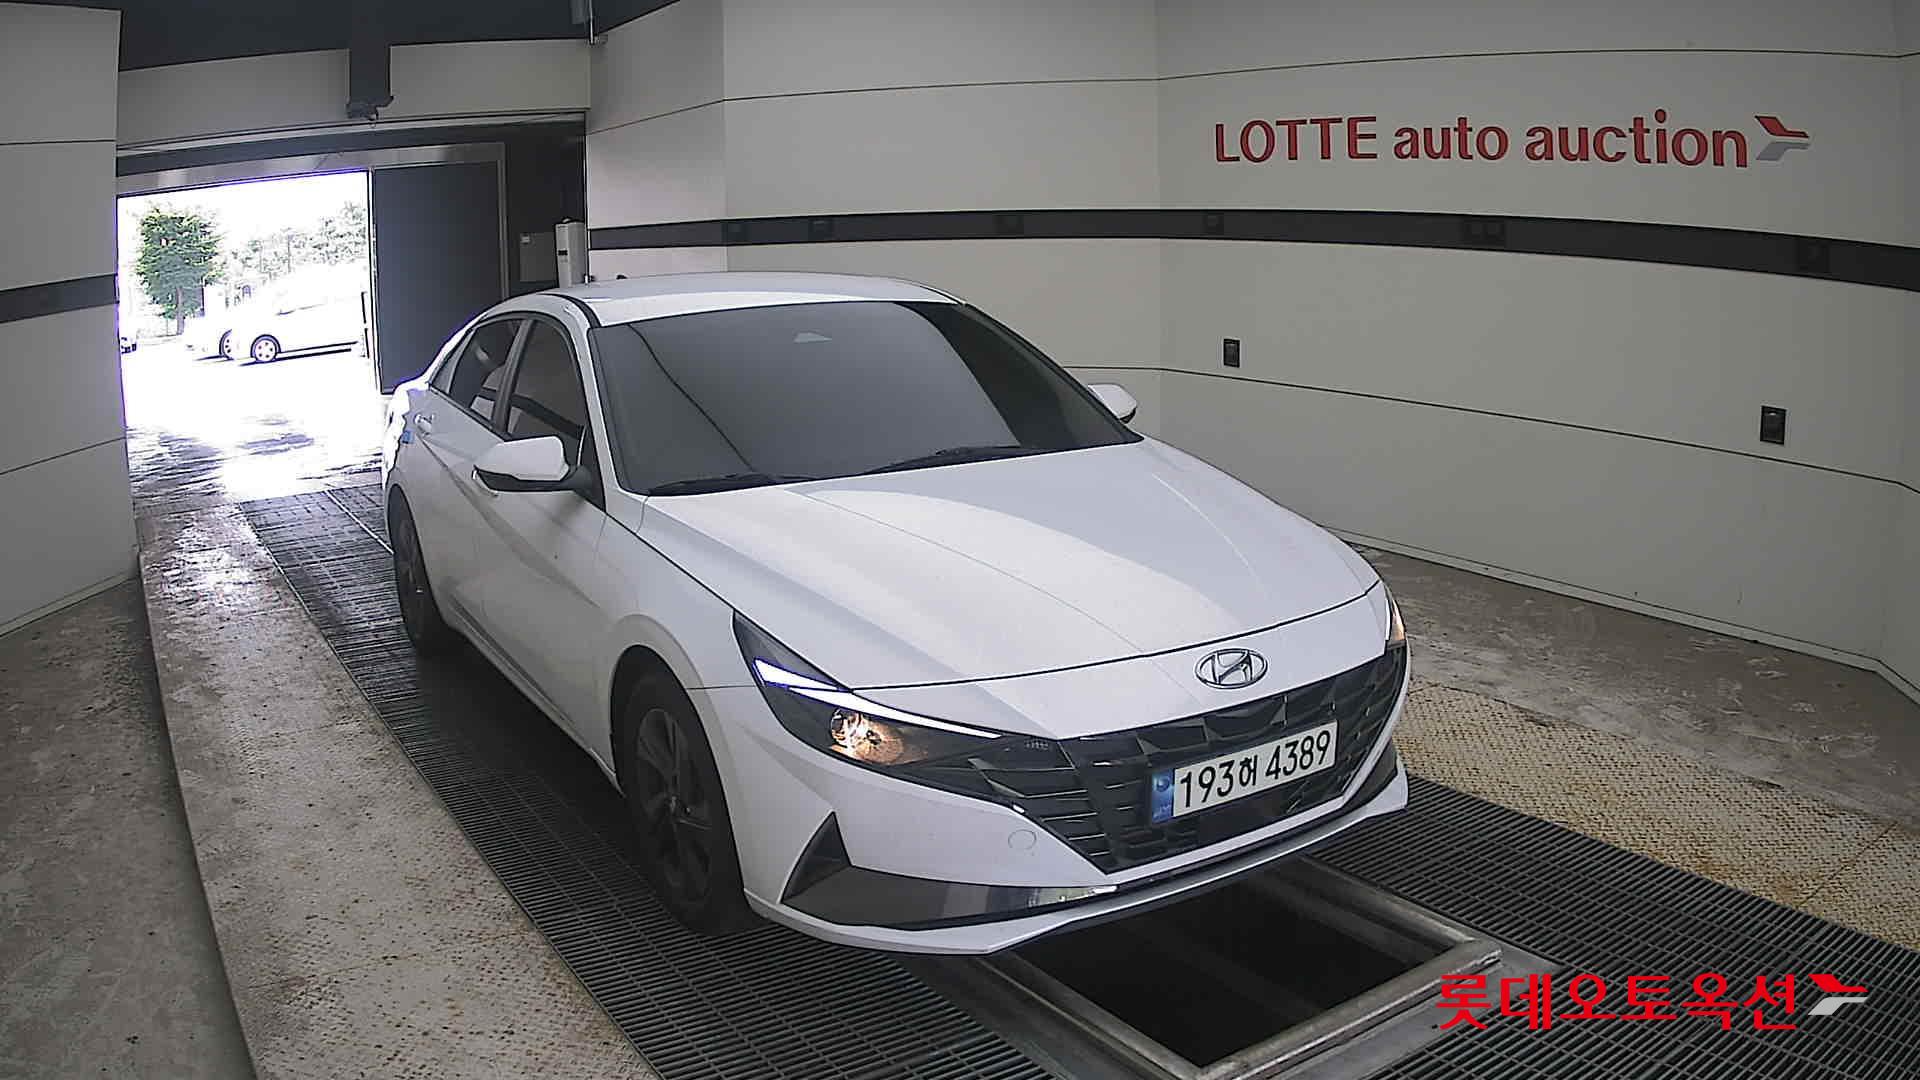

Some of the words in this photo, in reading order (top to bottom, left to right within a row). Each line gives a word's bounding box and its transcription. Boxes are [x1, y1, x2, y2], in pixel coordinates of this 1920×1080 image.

[1215, 116, 1377, 163] LOTTE
[1393, 117, 1509, 161] auto
[1525, 109, 1748, 168] auction
[1180, 755, 1258, 808] 193허
[1265, 730, 1331, 780] 4389
